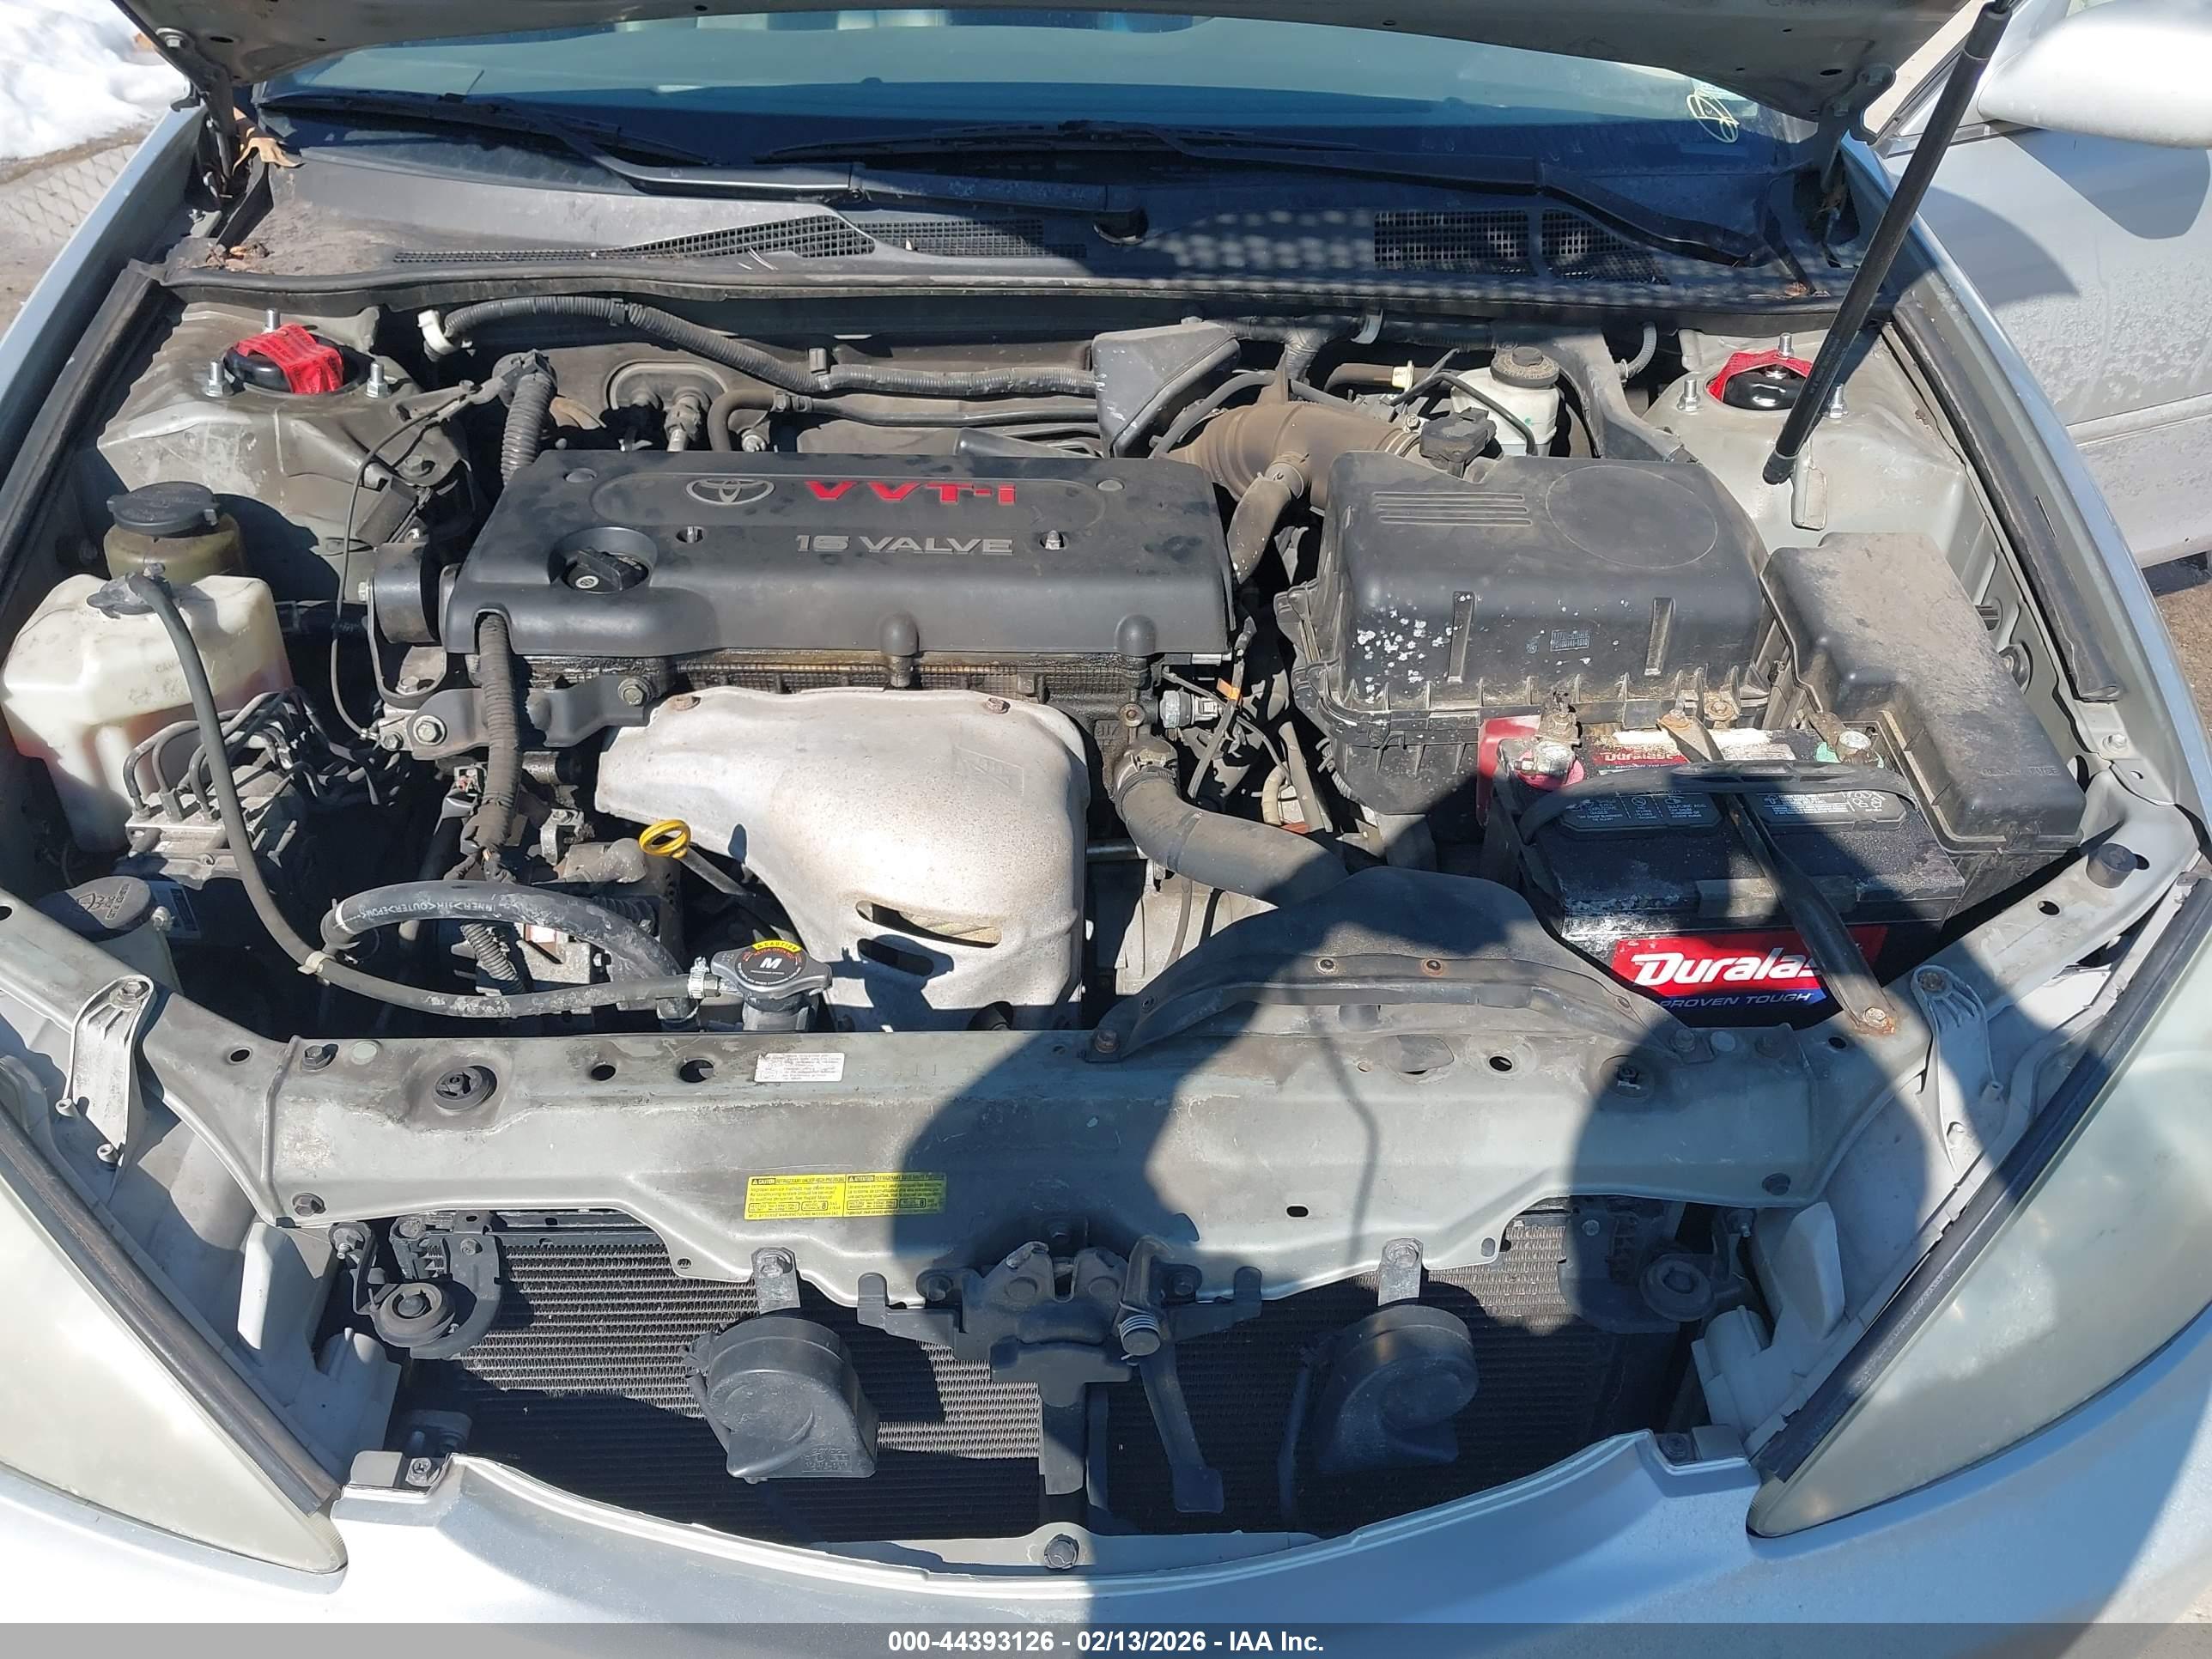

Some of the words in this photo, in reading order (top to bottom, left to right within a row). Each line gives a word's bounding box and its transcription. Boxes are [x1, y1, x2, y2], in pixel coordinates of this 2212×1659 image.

[795, 535, 851, 553] 16
[859, 536, 1013, 556] VALVE
[760, 957, 783, 969] M
[1631, 948, 1822, 987] Duralas
[1660, 996, 1740, 1008] PROVEN
[1747, 993, 1810, 1005] TOUGH
